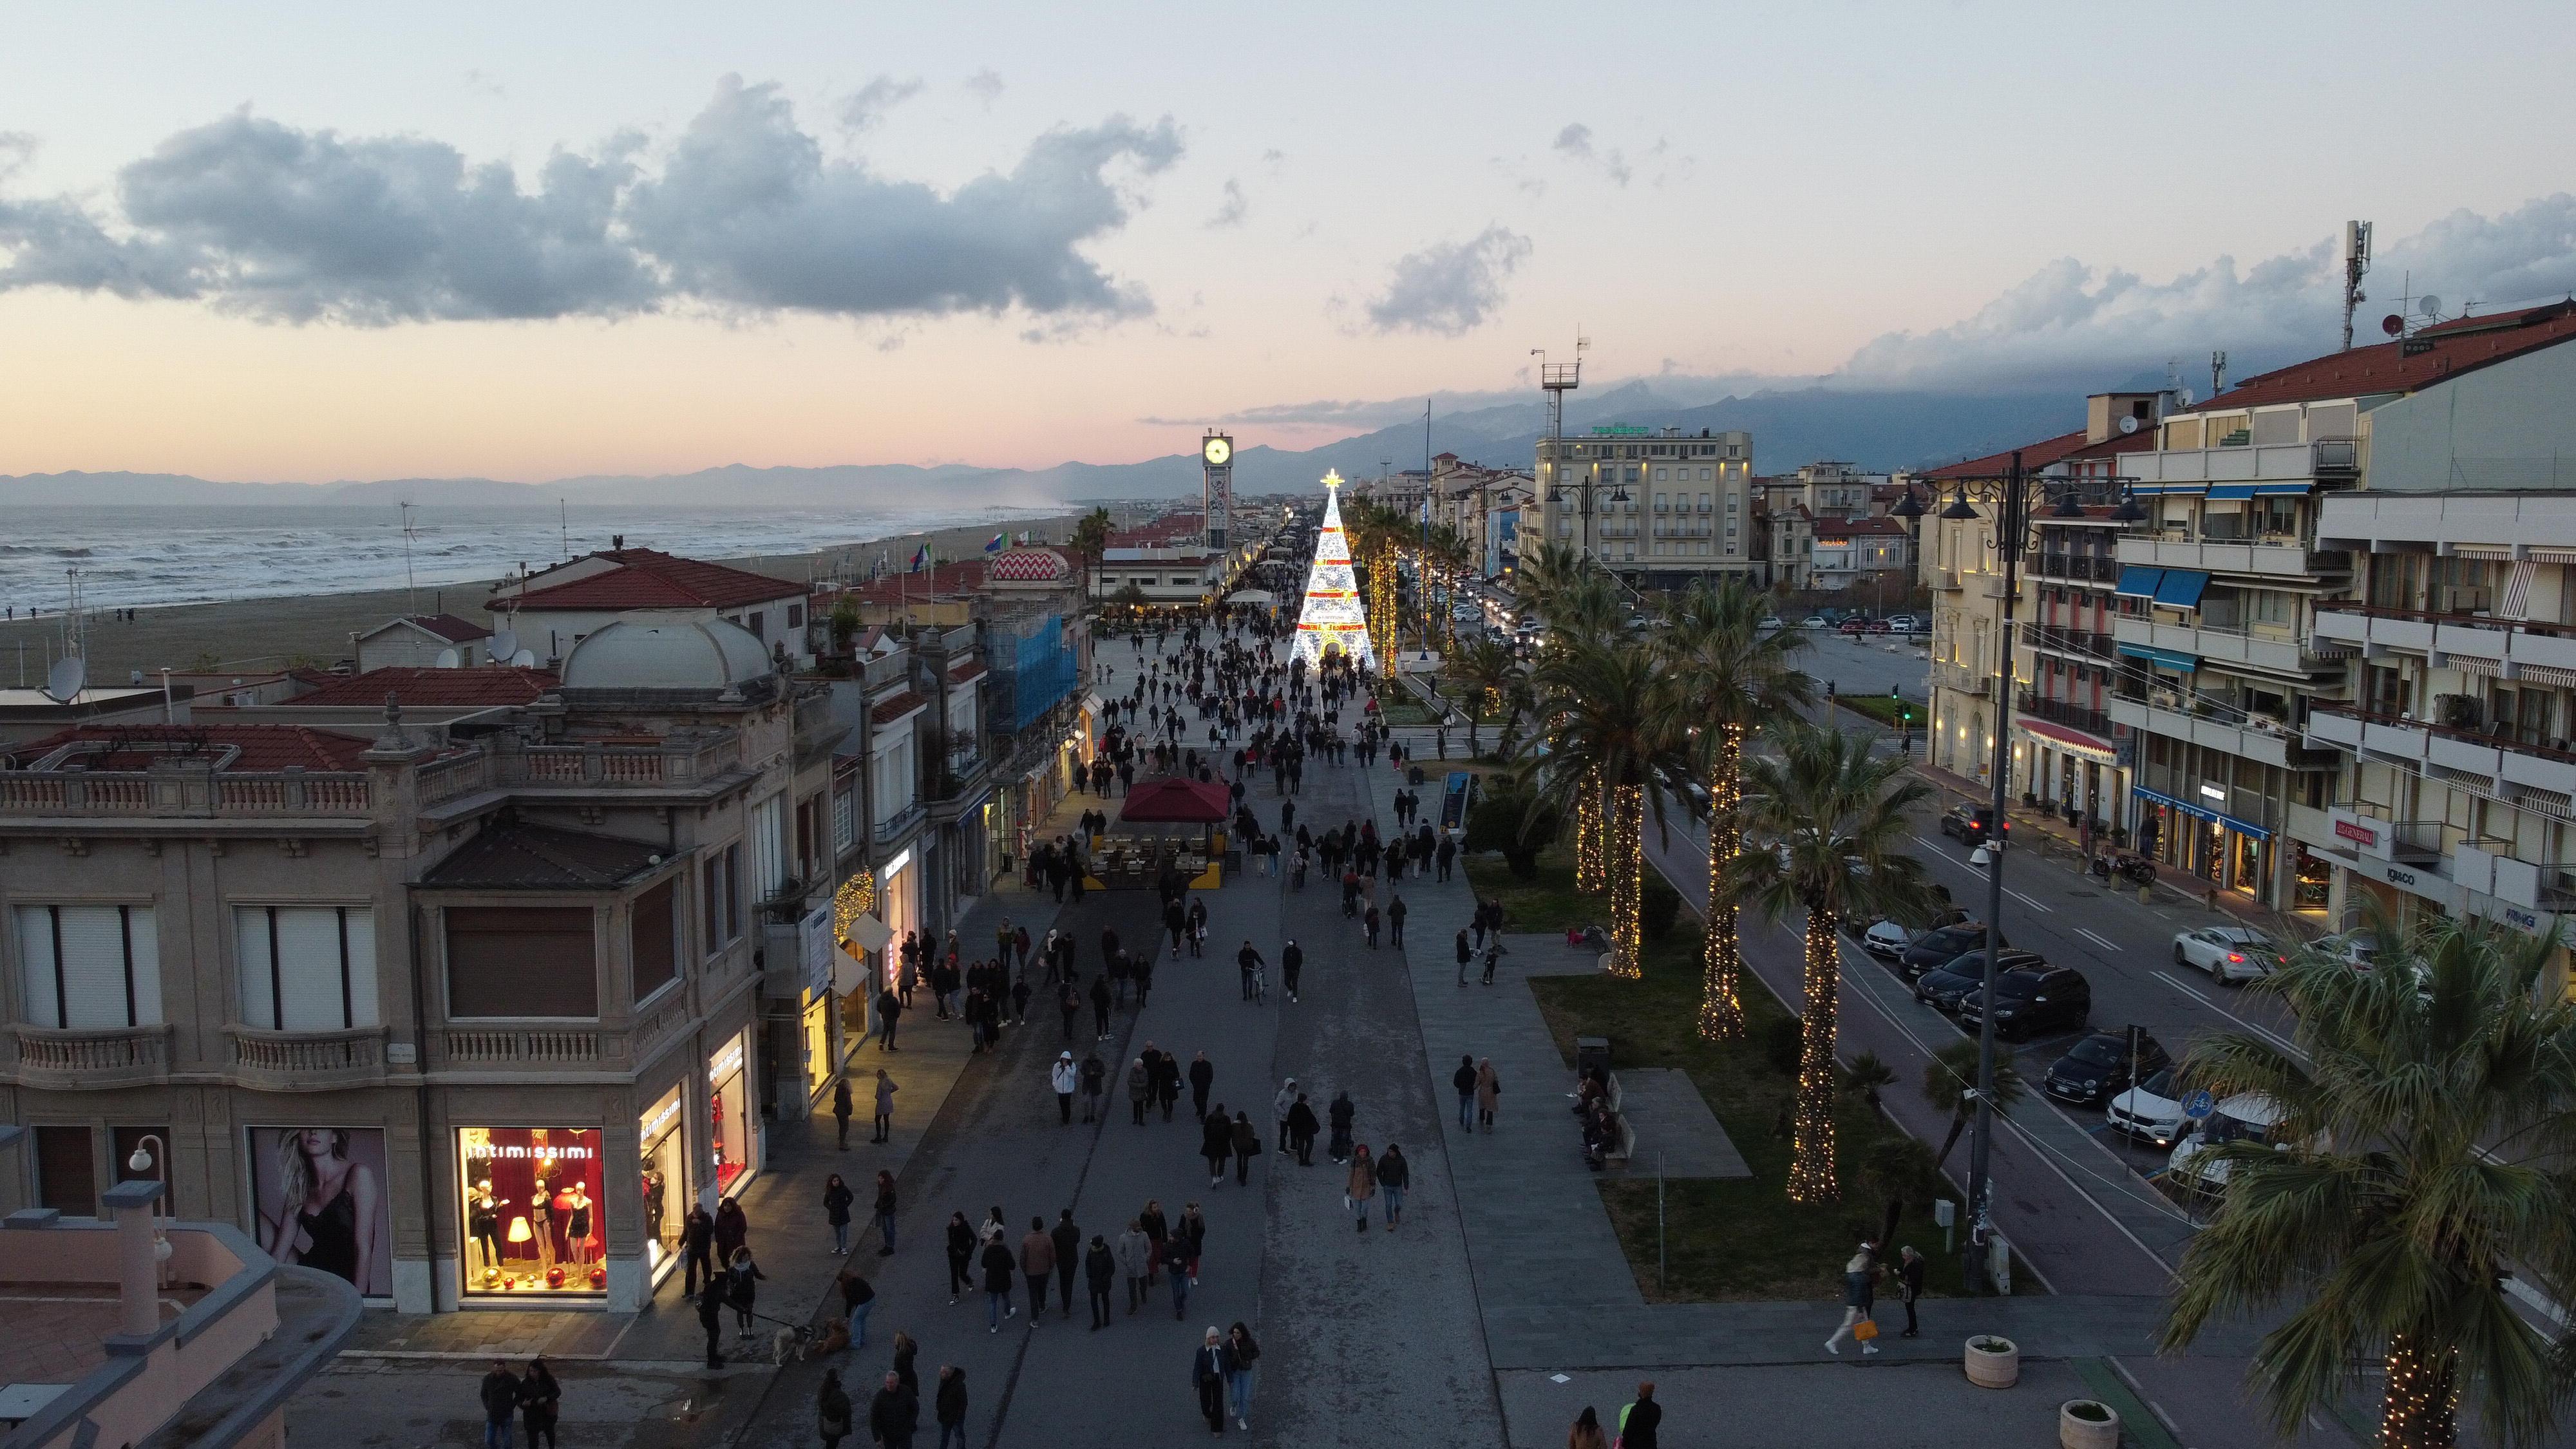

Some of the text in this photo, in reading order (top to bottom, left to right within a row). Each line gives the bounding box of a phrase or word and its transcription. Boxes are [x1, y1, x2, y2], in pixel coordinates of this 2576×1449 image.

[2345, 826, 2372, 843] GENERALI
[710, 1045, 743, 1082] ntimissimi
[640, 1097, 681, 1142] ntimissimi
[468, 1143, 594, 1159] intimissimi
